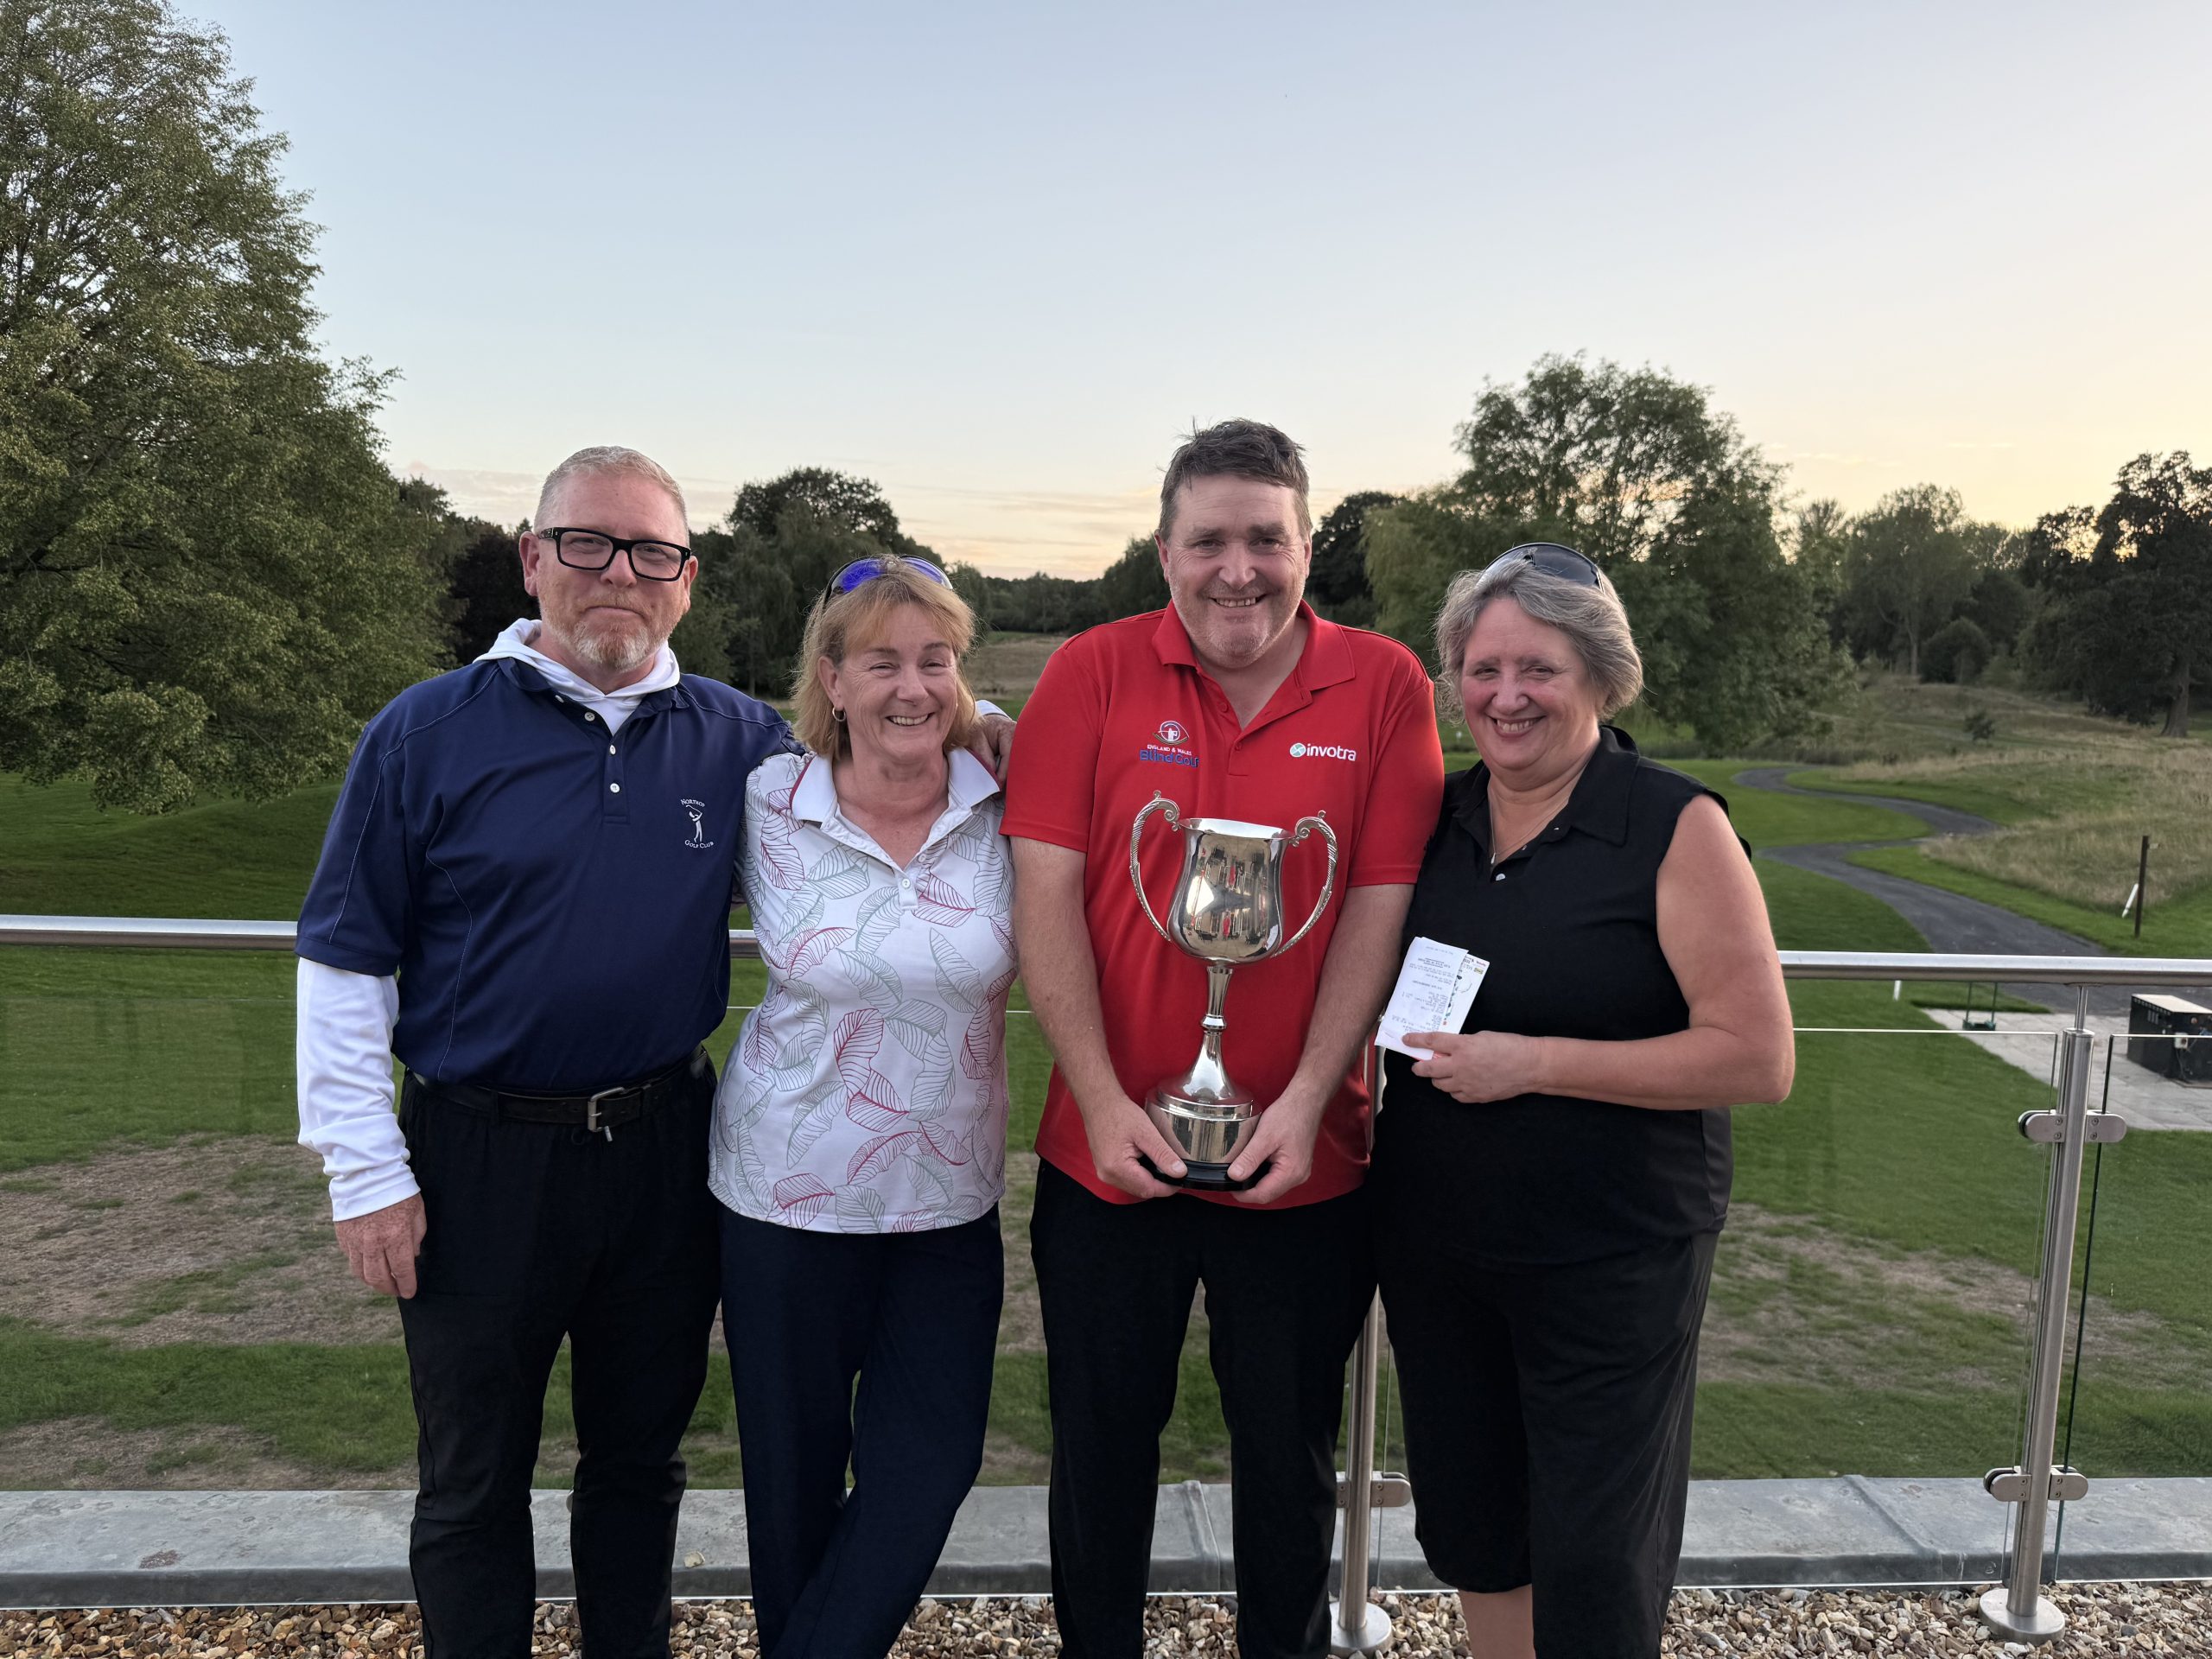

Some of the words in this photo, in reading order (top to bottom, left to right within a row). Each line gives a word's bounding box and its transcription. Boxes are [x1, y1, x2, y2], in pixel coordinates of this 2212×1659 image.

[1140, 749, 1174, 763] Blind
[1175, 753, 1199, 767] Golf
[1177, 747, 1192, 756] WALES
[1306, 743, 1357, 761] invotra
